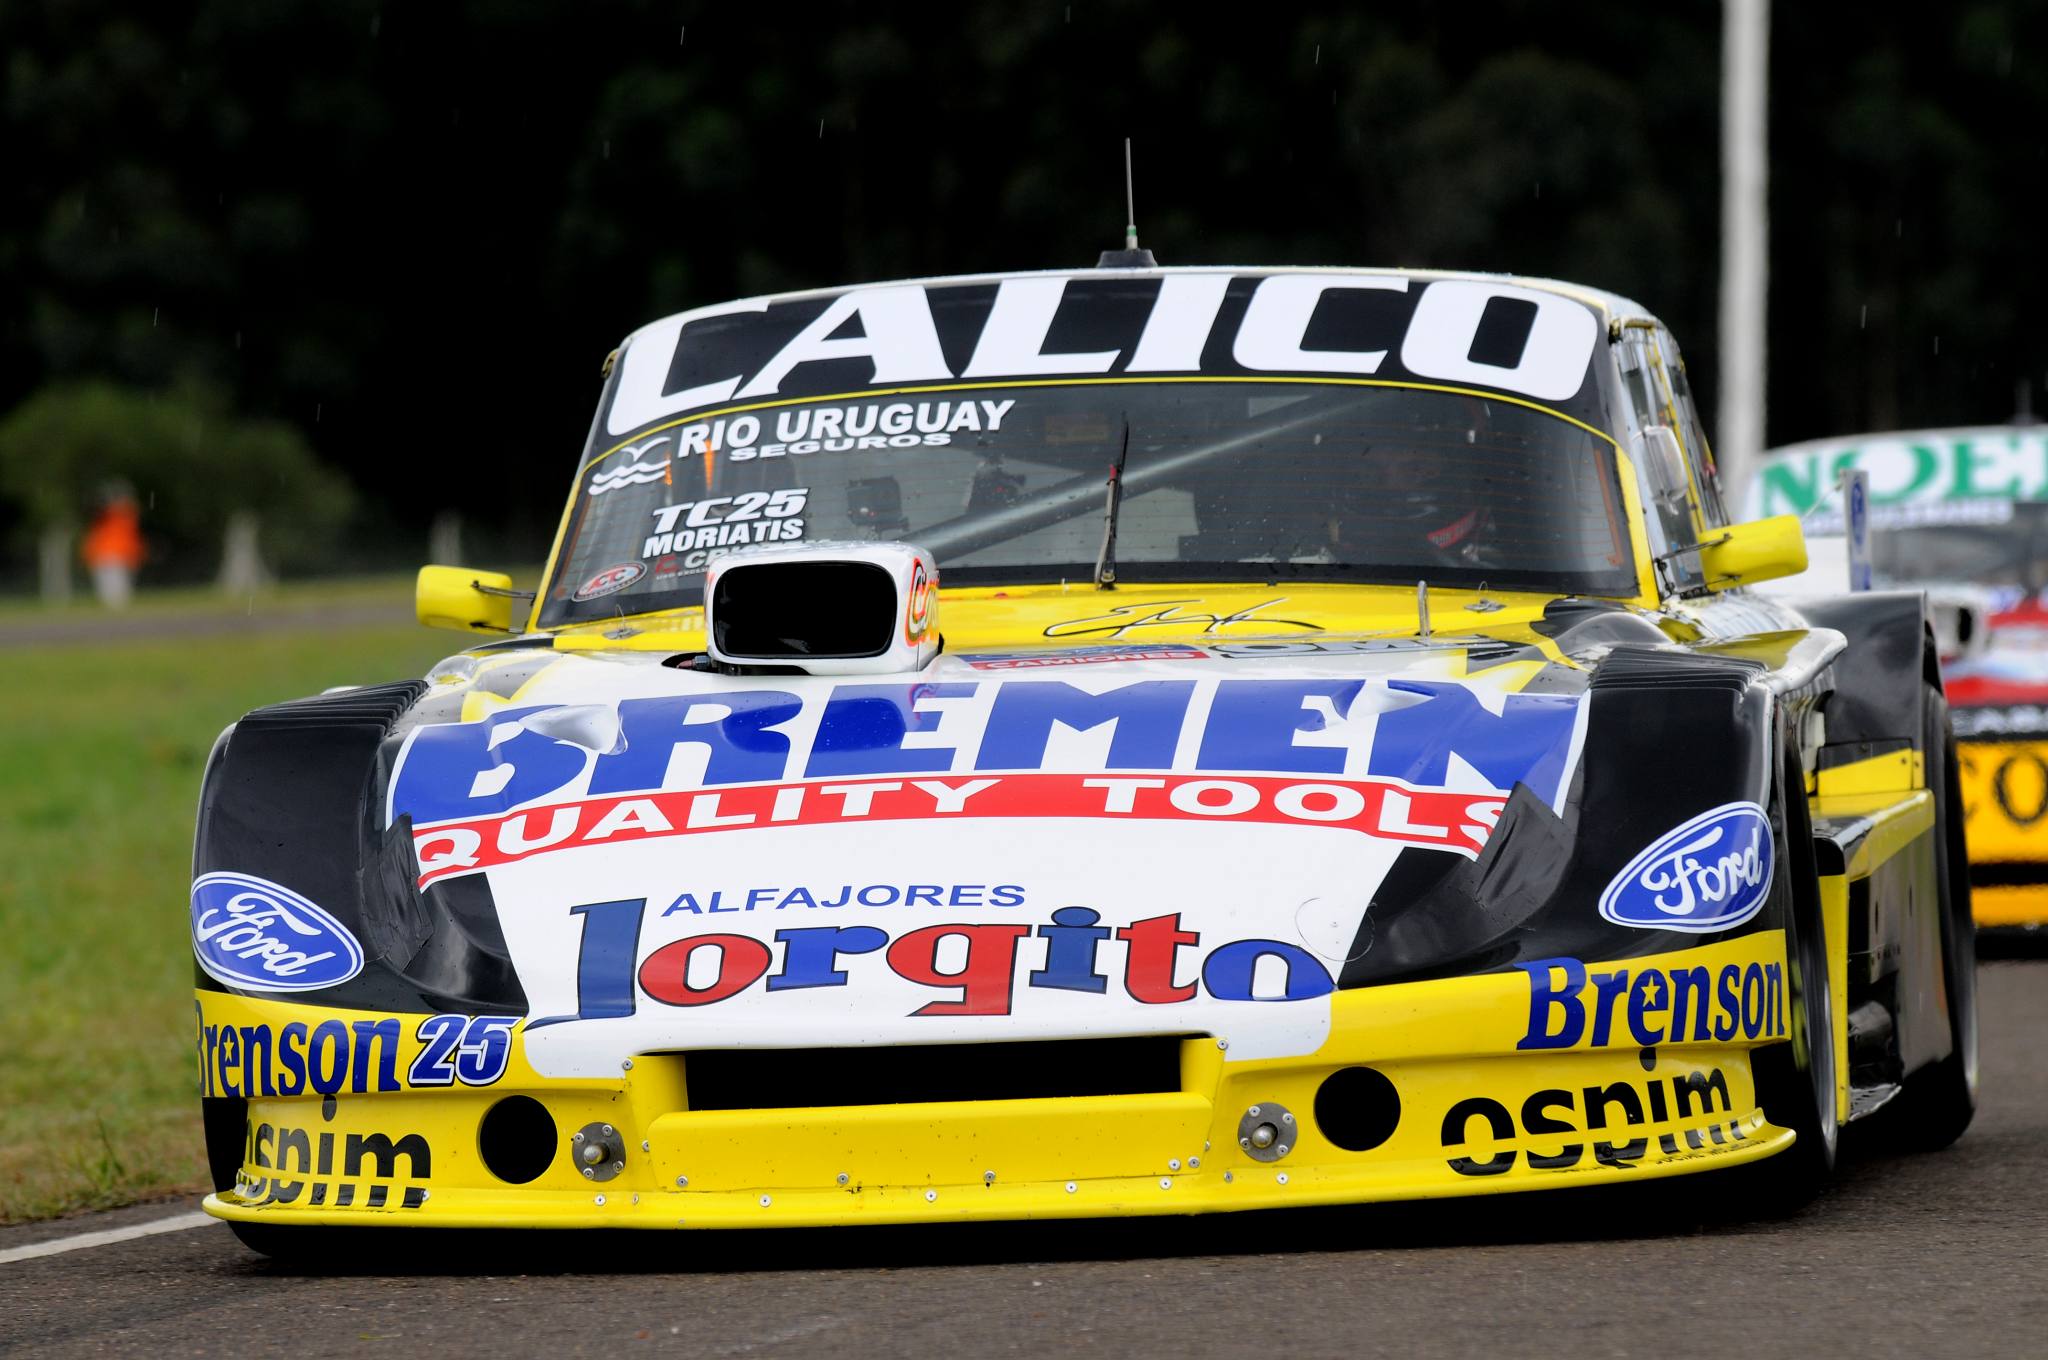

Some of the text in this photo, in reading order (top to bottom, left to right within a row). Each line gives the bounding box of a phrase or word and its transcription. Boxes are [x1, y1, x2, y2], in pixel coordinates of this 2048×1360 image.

[608, 275, 1599, 436] CALICO
[678, 400, 1016, 458] RIO URUGUAY
[729, 432, 952, 462] SEGUROS
[651, 488, 810, 534] TC25
[1762, 434, 2048, 517] NOE
[642, 518, 804, 560] MORIATIS
[986, 651, 1195, 669] CAMIONES
[398, 678, 1582, 826] BREMEN
[416, 778, 1504, 868] QUALITY TOOLS
[661, 884, 1026, 917] ALFAJORES
[1640, 825, 1764, 917] Ford
[197, 891, 337, 978] Ford
[1513, 956, 1786, 1050] Brenson
[407, 1012, 523, 1088] 25
[1441, 1046, 1748, 1177] ospim
